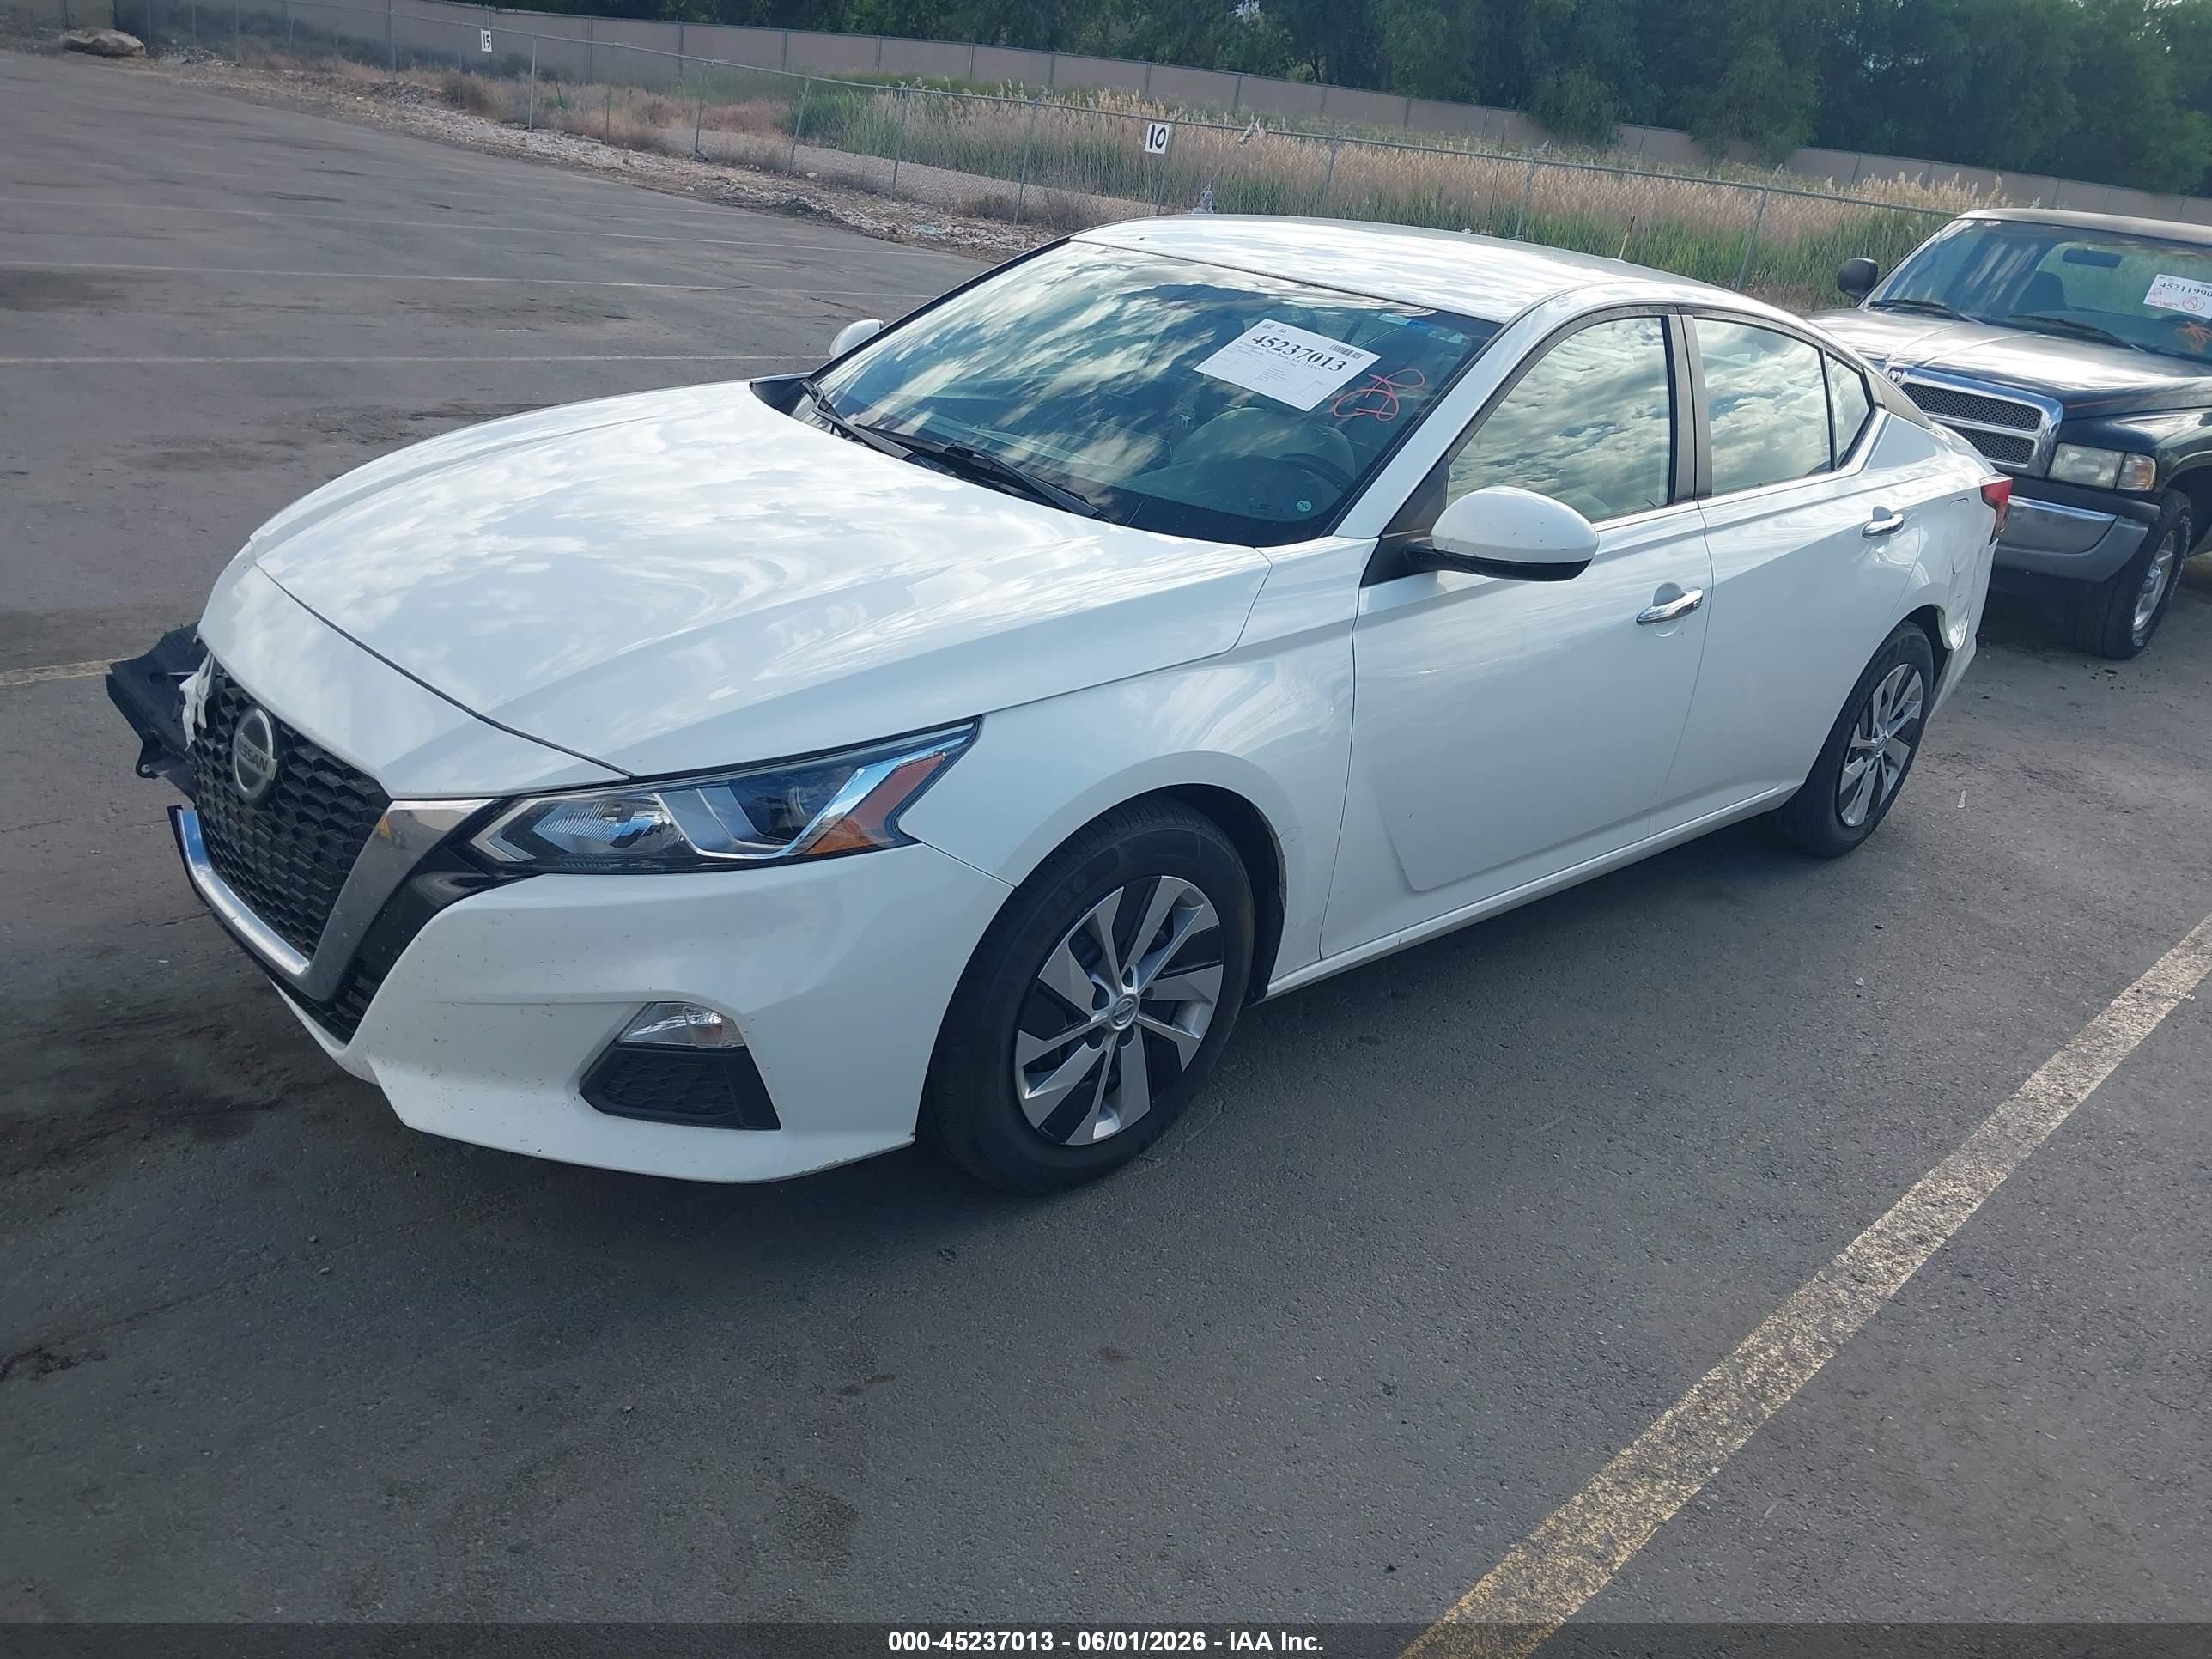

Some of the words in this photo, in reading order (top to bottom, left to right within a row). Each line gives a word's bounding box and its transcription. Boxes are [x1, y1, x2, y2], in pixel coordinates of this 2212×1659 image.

[483, 33, 491, 49] 15
[1149, 124, 1167, 149] 10
[1252, 335, 1347, 371] 45237013
